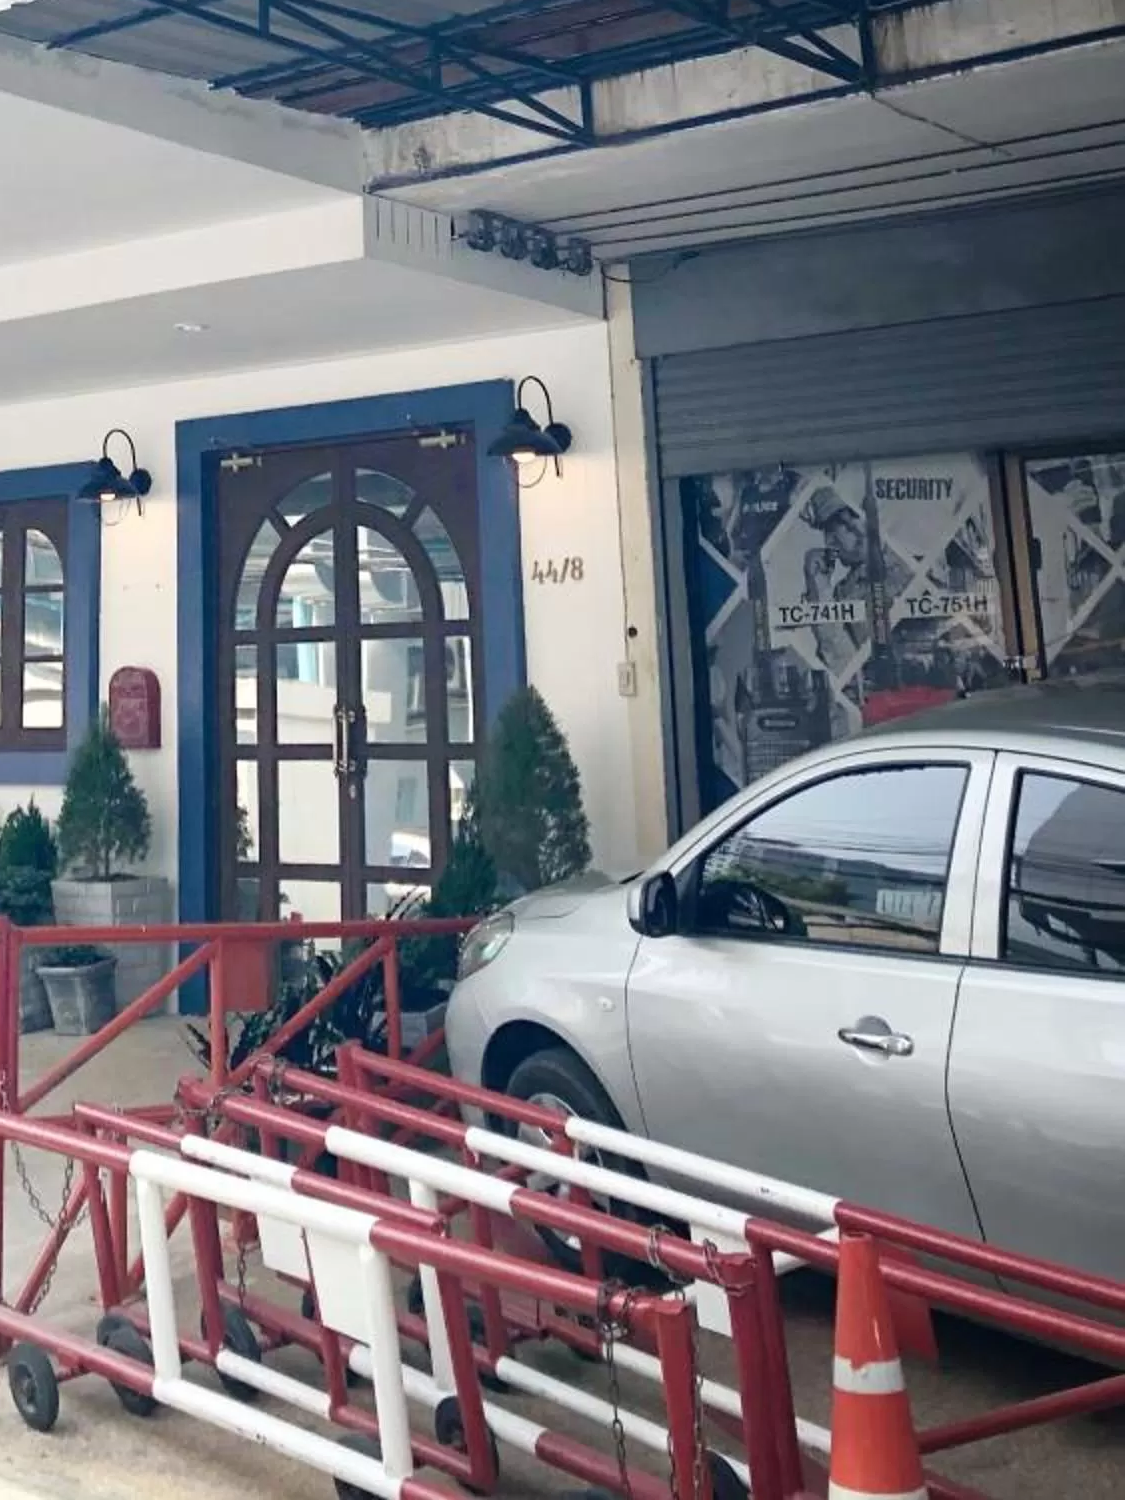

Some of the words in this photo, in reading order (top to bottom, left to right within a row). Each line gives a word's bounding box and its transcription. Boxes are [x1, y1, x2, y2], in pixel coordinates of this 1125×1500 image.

[876, 478, 953, 500] SECURITY
[531, 556, 584, 585] 44/8
[779, 603, 854, 623] TC-741H
[906, 595, 988, 617] TC-751H
